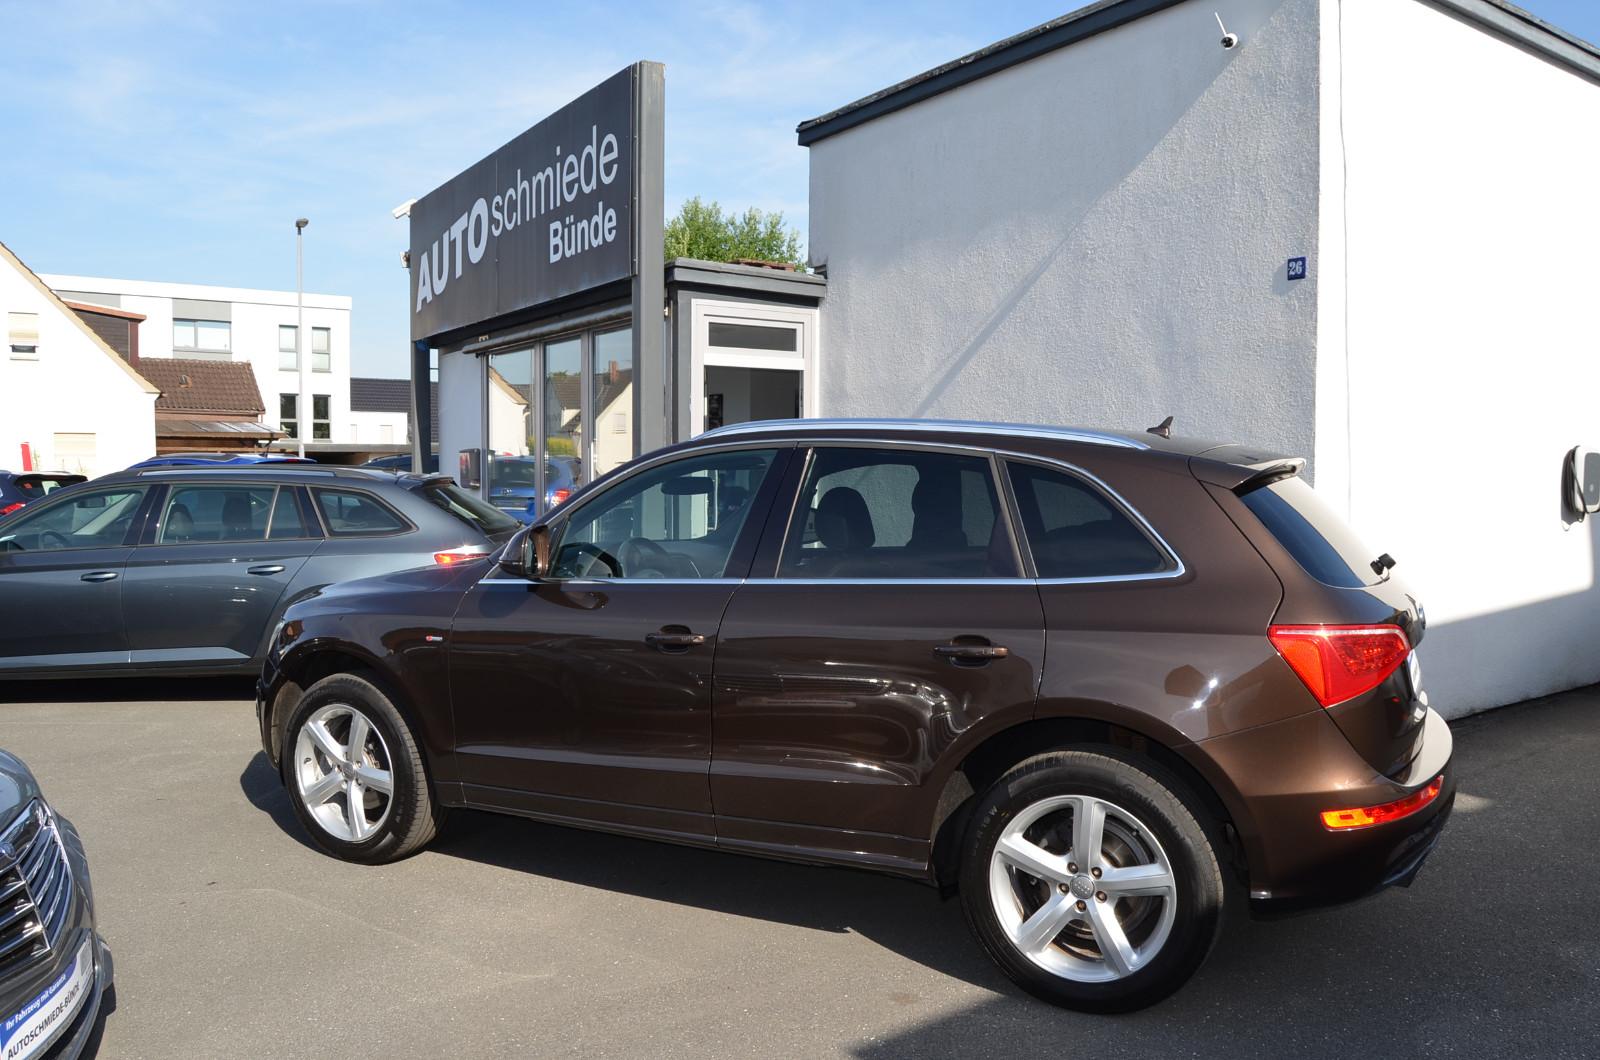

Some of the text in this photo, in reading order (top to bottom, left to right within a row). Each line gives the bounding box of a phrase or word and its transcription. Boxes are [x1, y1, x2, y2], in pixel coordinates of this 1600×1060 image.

[550, 202, 617, 264] Bünde
[1289, 261, 1303, 275] 26
[6, 1019, 15, 1031] Ihr
[15, 999, 41, 1023] Fahrzeug
[41, 990, 49, 1002] mit
